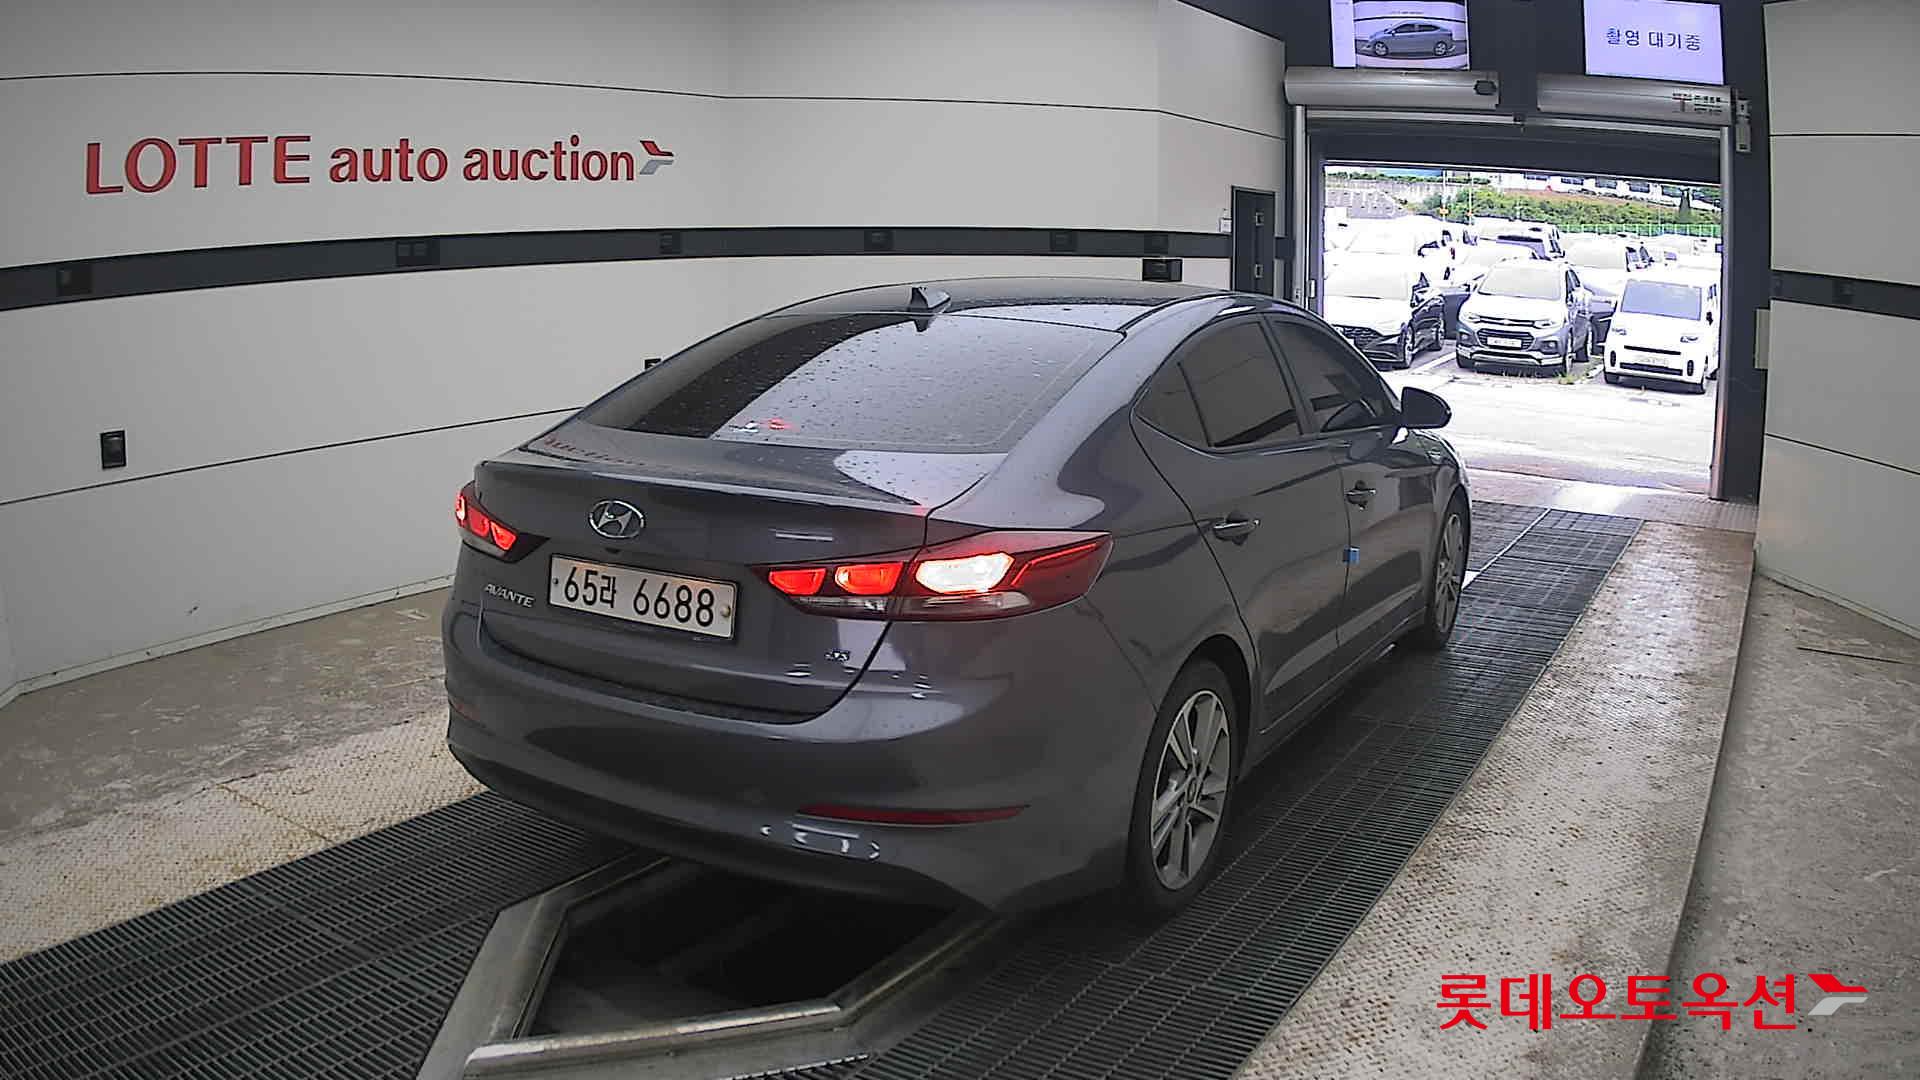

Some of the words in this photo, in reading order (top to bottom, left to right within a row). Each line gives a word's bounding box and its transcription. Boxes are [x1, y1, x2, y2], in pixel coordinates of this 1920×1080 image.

[1607, 27, 1640, 47] 촬영
[1648, 32, 1700, 51] 대기중
[85, 135, 311, 195] LOTTE
[328, 138, 448, 183] auto
[463, 134, 634, 181] auction
[484, 583, 535, 608] AVANTE
[564, 566, 617, 609] 65라
[633, 578, 715, 627] 6688
